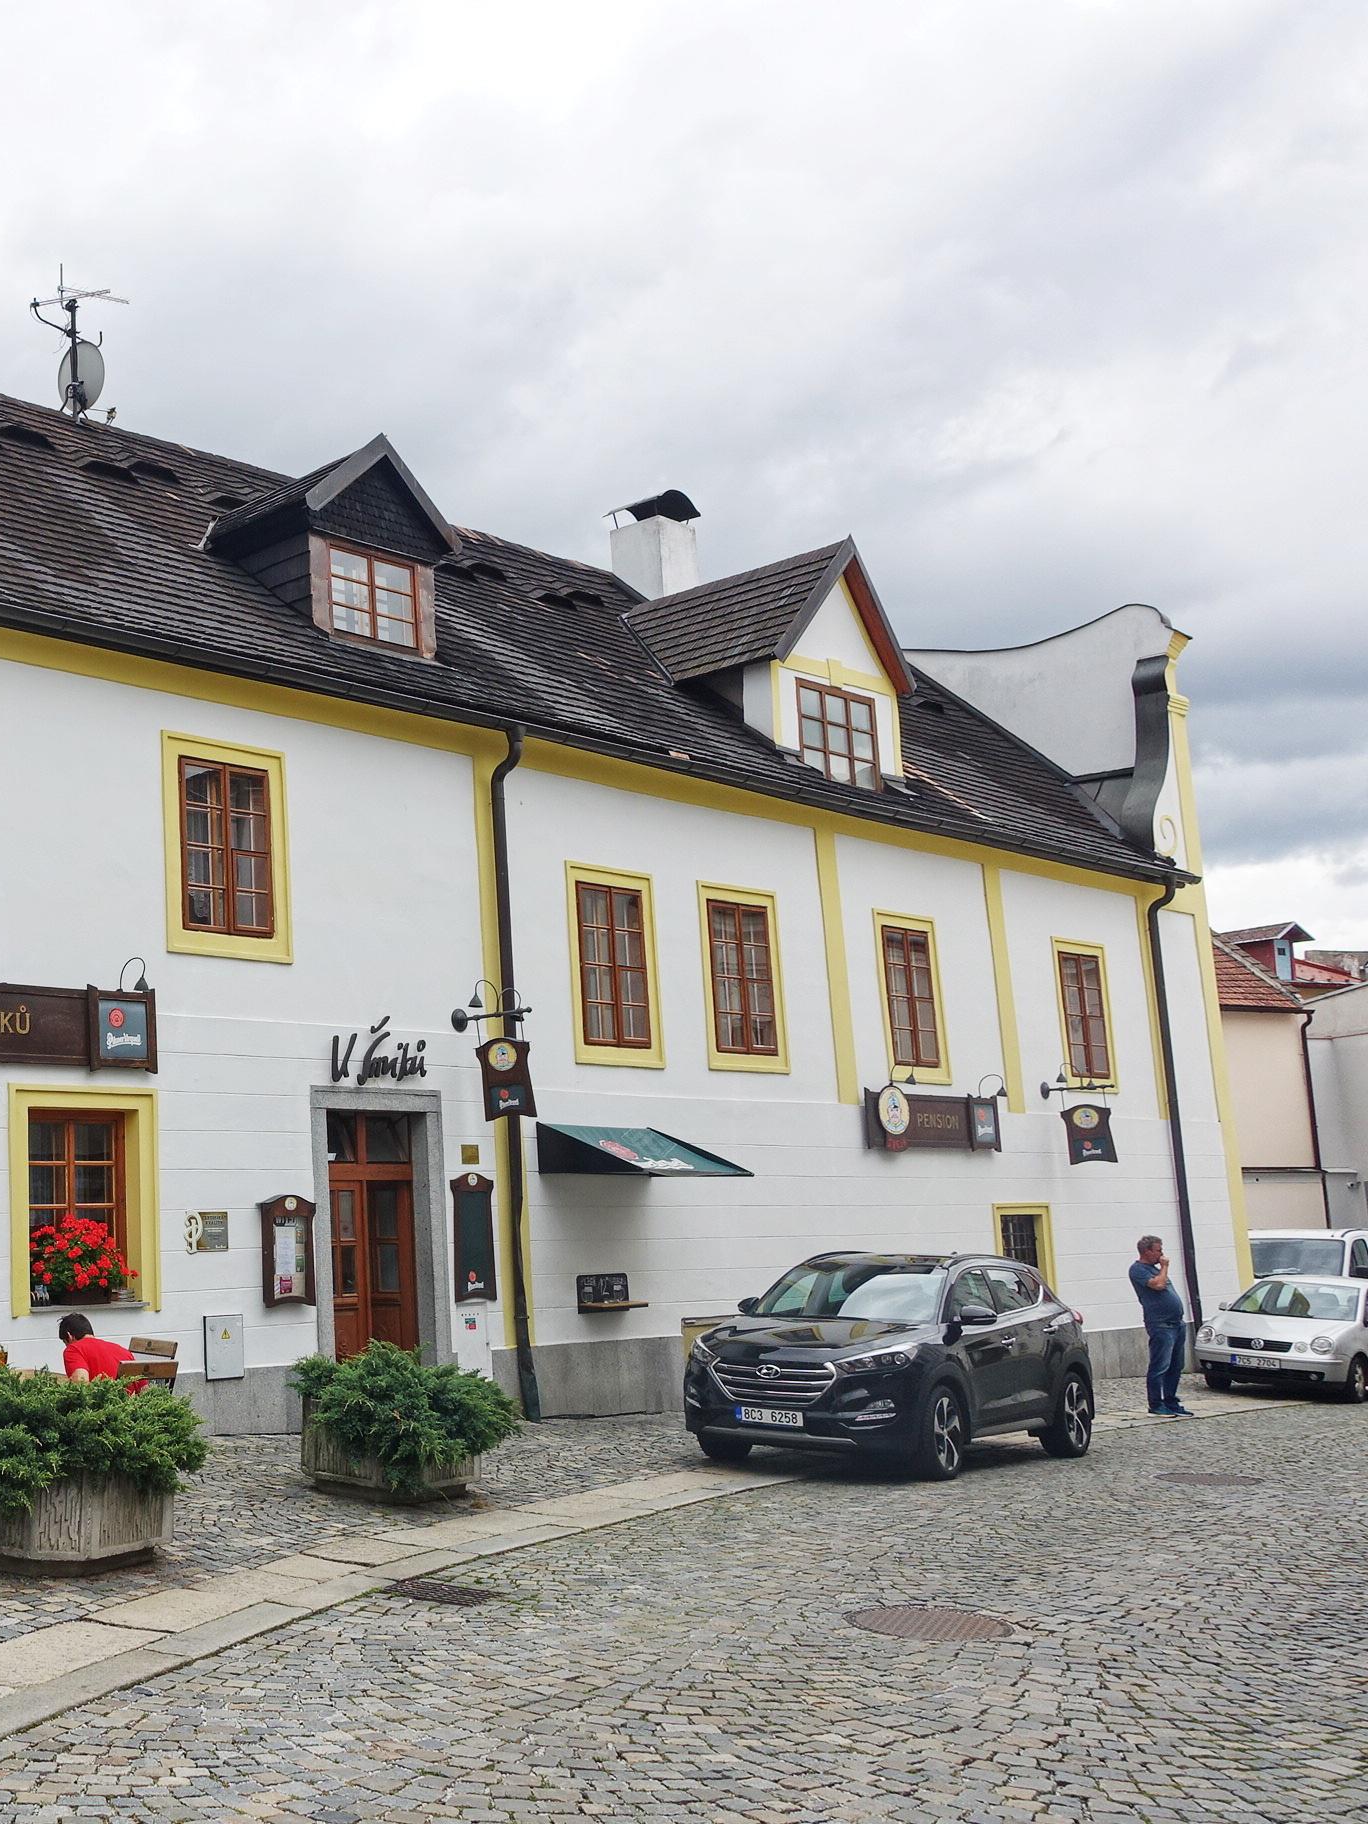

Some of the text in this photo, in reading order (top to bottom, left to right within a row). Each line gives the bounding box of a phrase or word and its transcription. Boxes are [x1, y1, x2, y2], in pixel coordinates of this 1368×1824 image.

[332, 1032, 357, 1082] U
[917, 1113, 960, 1129] PENSION
[743, 1408, 799, 1425] 8C3 6258
